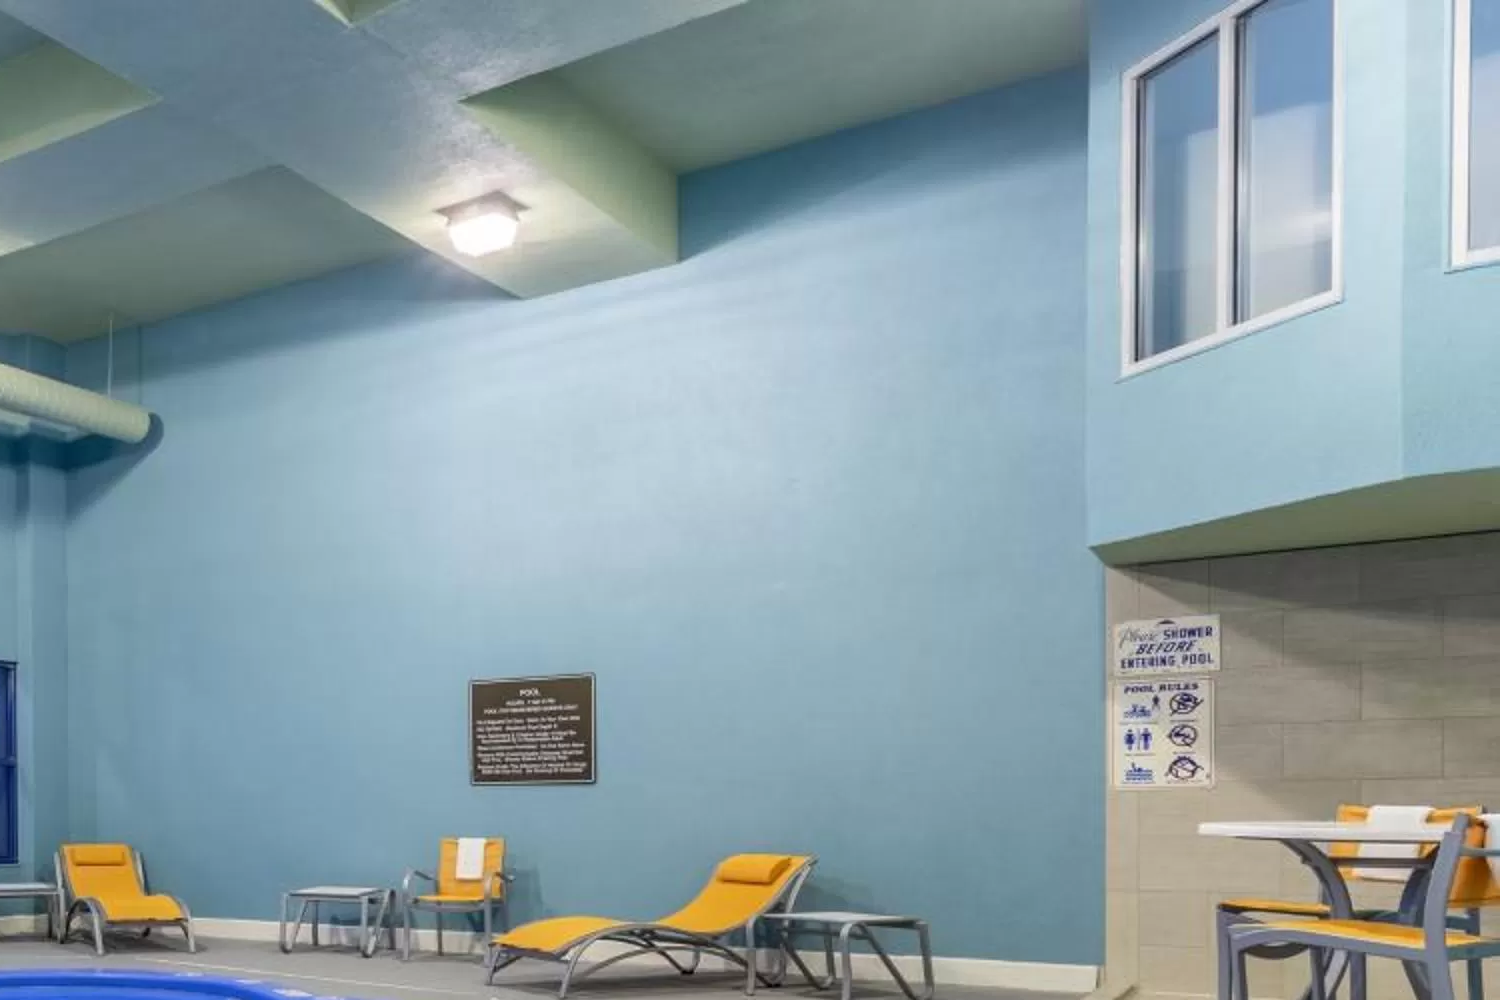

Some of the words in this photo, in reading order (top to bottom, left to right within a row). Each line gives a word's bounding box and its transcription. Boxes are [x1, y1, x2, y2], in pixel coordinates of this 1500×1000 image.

[1163, 625, 1213, 640] SHOWER
[1136, 640, 1197, 654] BEFORE
[1120, 655, 1176, 669] ENTERING
[1181, 652, 1214, 665] POOL
